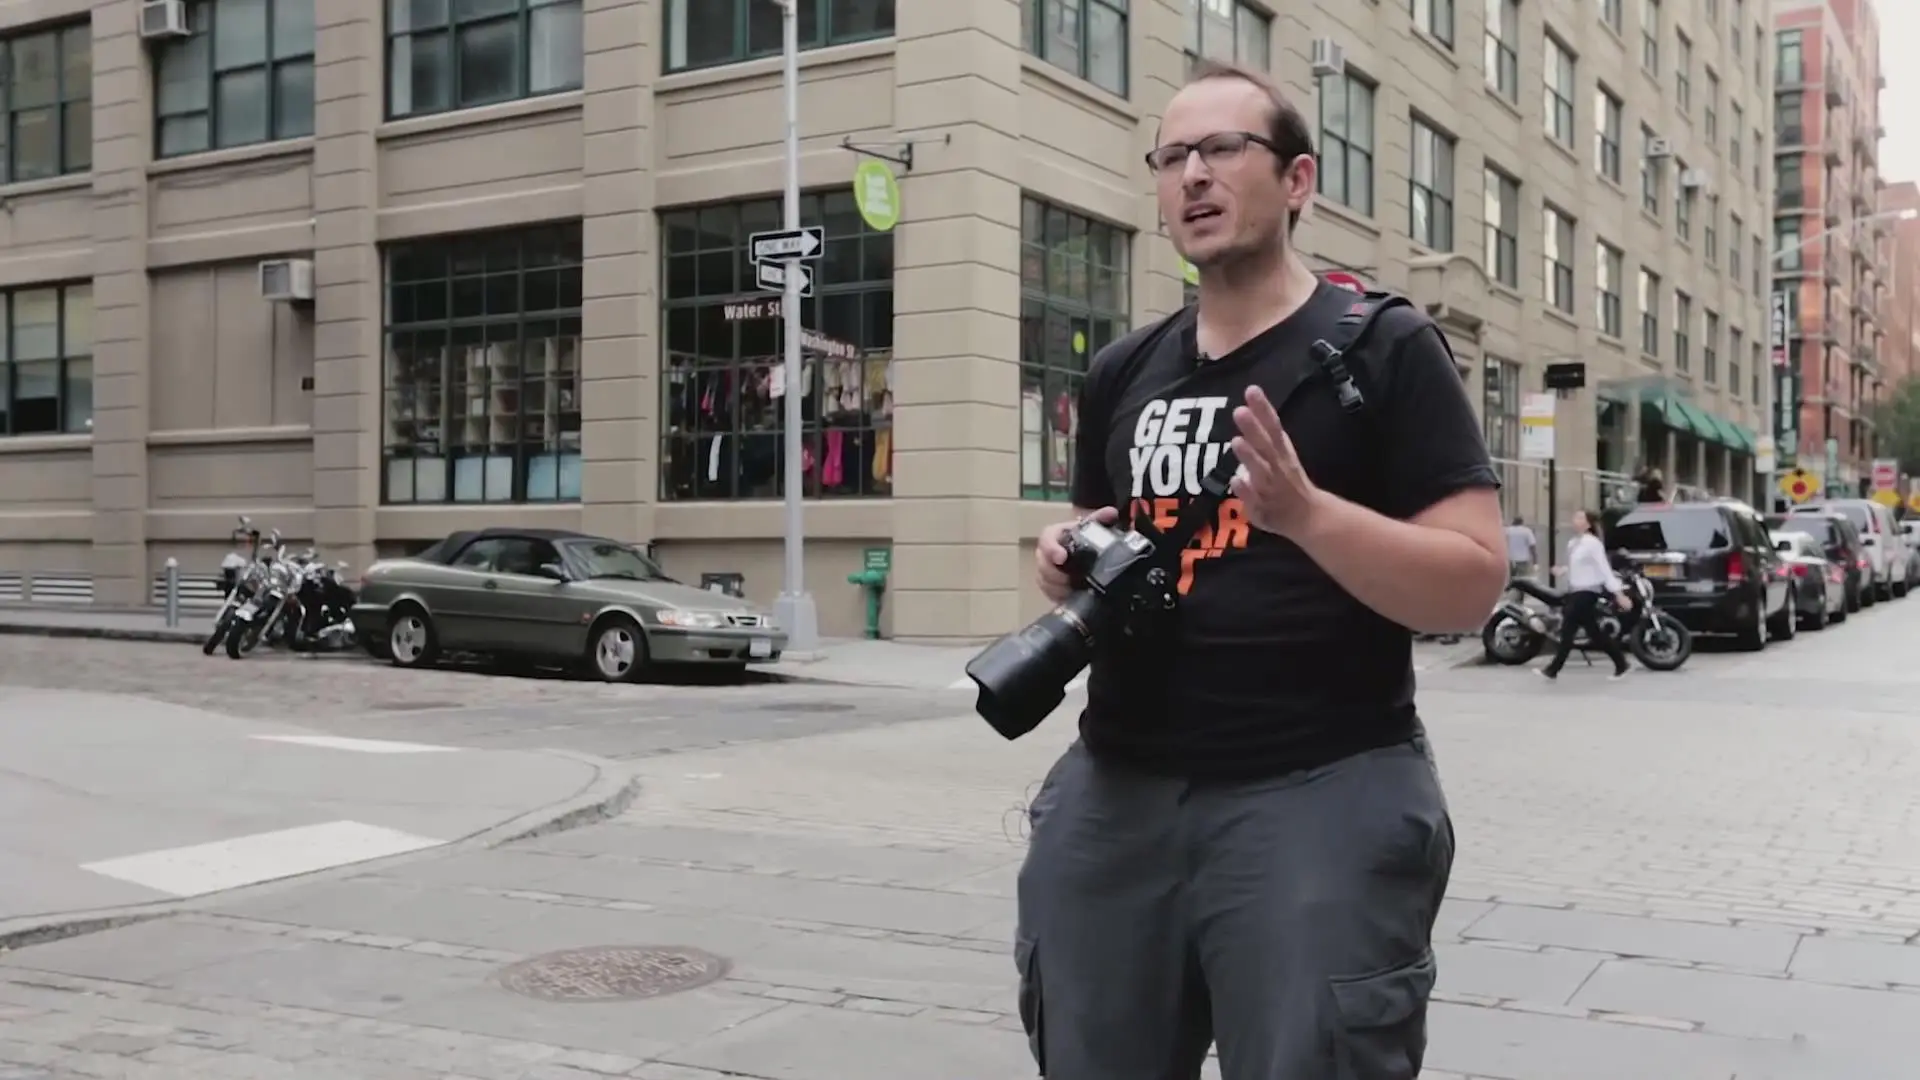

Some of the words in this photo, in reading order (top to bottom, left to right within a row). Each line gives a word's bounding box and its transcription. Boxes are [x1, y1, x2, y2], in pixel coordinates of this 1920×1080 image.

[723, 303, 763, 320] Water
[767, 301, 780, 317] St
[1134, 396, 1228, 447] GET
